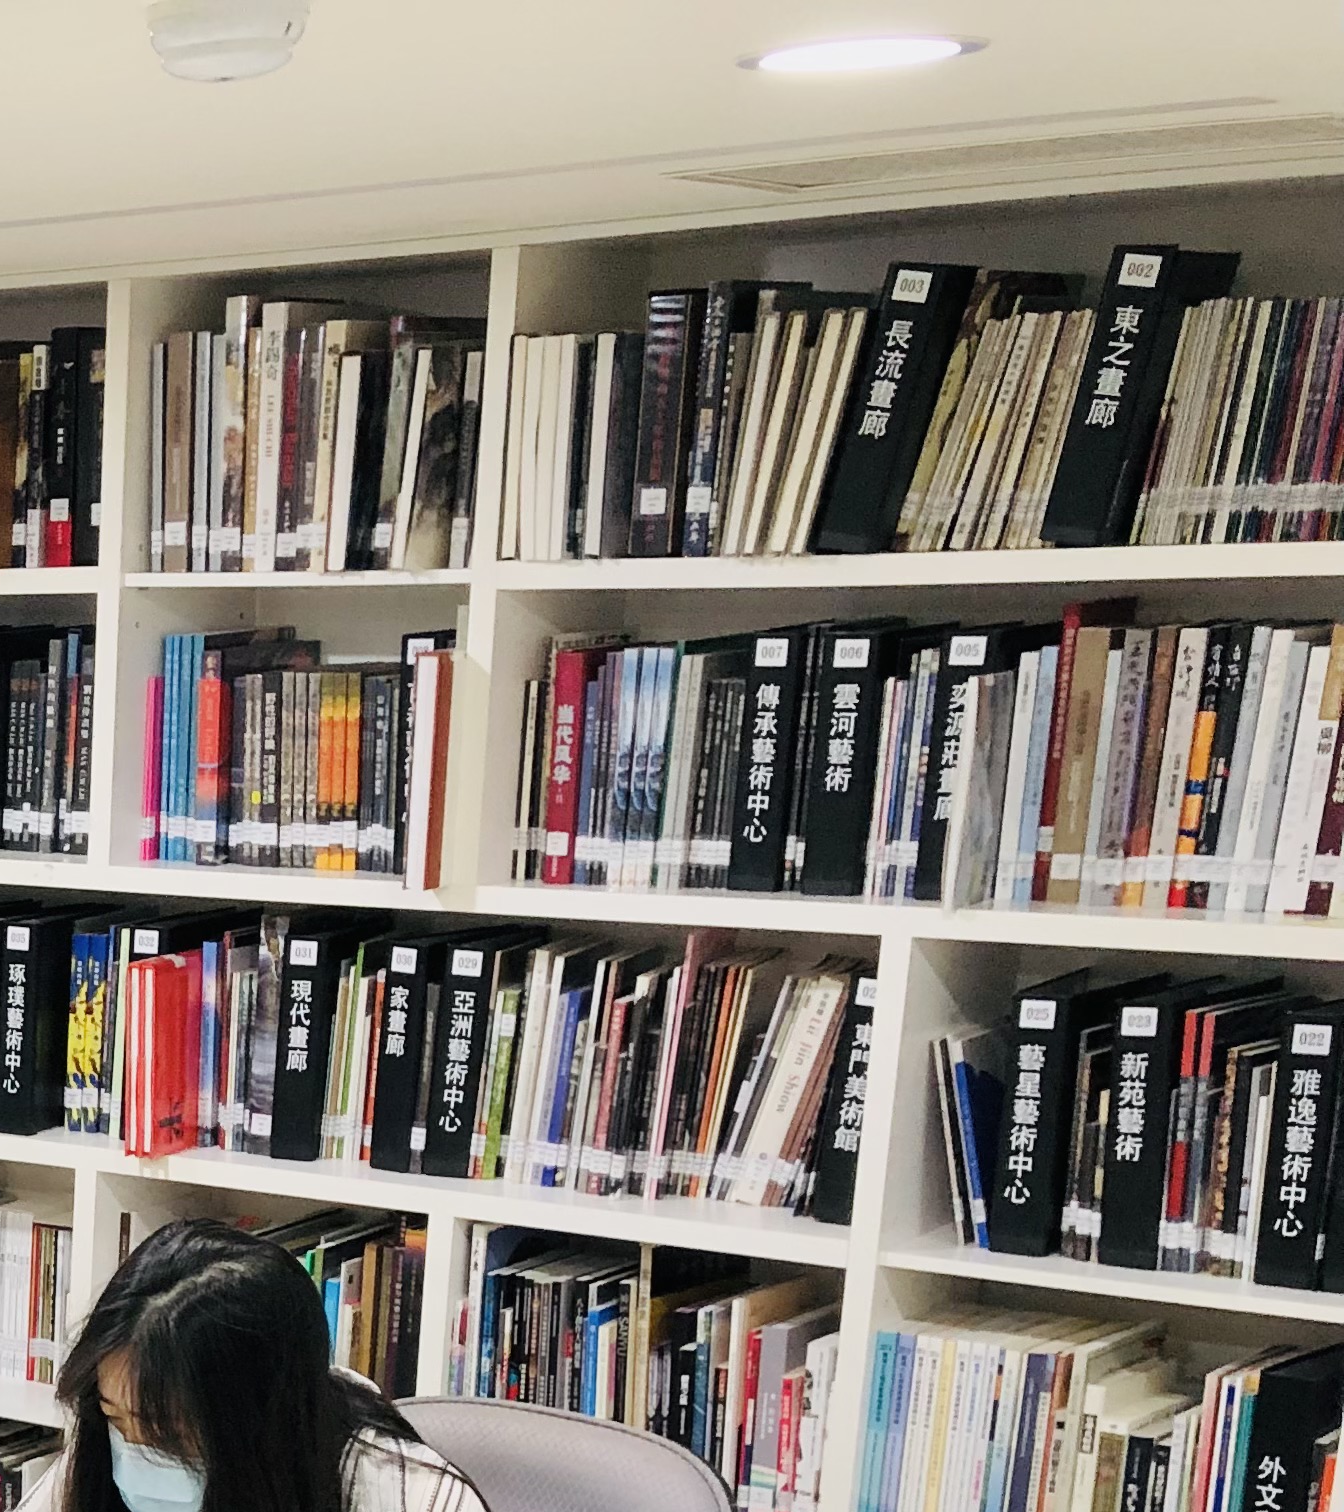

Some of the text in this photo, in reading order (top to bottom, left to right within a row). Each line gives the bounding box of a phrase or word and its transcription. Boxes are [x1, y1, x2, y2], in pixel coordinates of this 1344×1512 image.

[898, 278, 925, 294] 003
[1126, 261, 1154, 279] 002
[858, 318, 914, 440] 長流畫廊
[1085, 304, 1146, 429] 東之畫廊
[759, 645, 783, 660] 007
[839, 646, 865, 661] 006
[955, 644, 979, 656] 005
[743, 684, 781, 843] 傳承藝術中心
[825, 684, 861, 793] 雲河藝術
[295, 947, 312, 958] 031
[286, 980, 312, 1072] 現代畫廊
[385, 986, 408, 1058] 家畫廊
[438, 991, 476, 1132] 亞洲藝術中心
[1003, 1044, 1046, 1205] 藝星藝術中心
[1114, 1052, 1149, 1162] 新苑藝術
[1273, 1070, 1322, 1238] 雅逸藝術中心
[617, 1317, 630, 1356] SANYU
